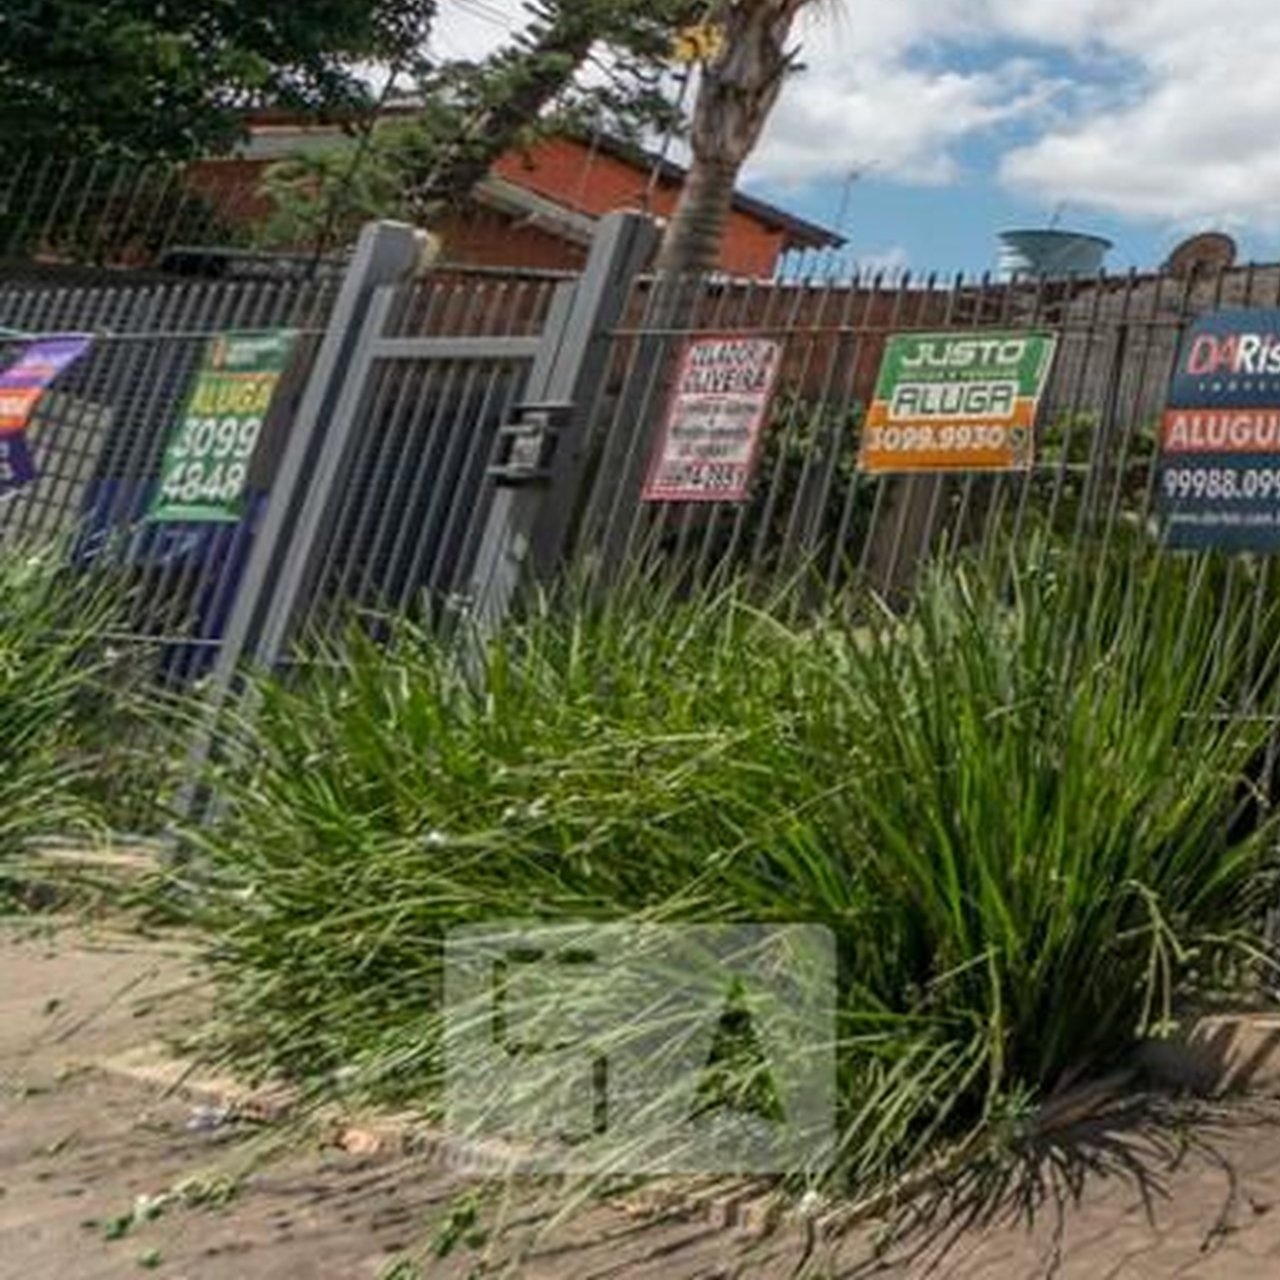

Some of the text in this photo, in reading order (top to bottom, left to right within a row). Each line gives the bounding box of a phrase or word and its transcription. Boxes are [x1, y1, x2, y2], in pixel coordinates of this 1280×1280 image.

[900, 339, 1026, 366] JUSTO
[892, 384, 1014, 416] ALUGA
[166, 416, 262, 458] 3099
[162, 462, 246, 500] 4848
